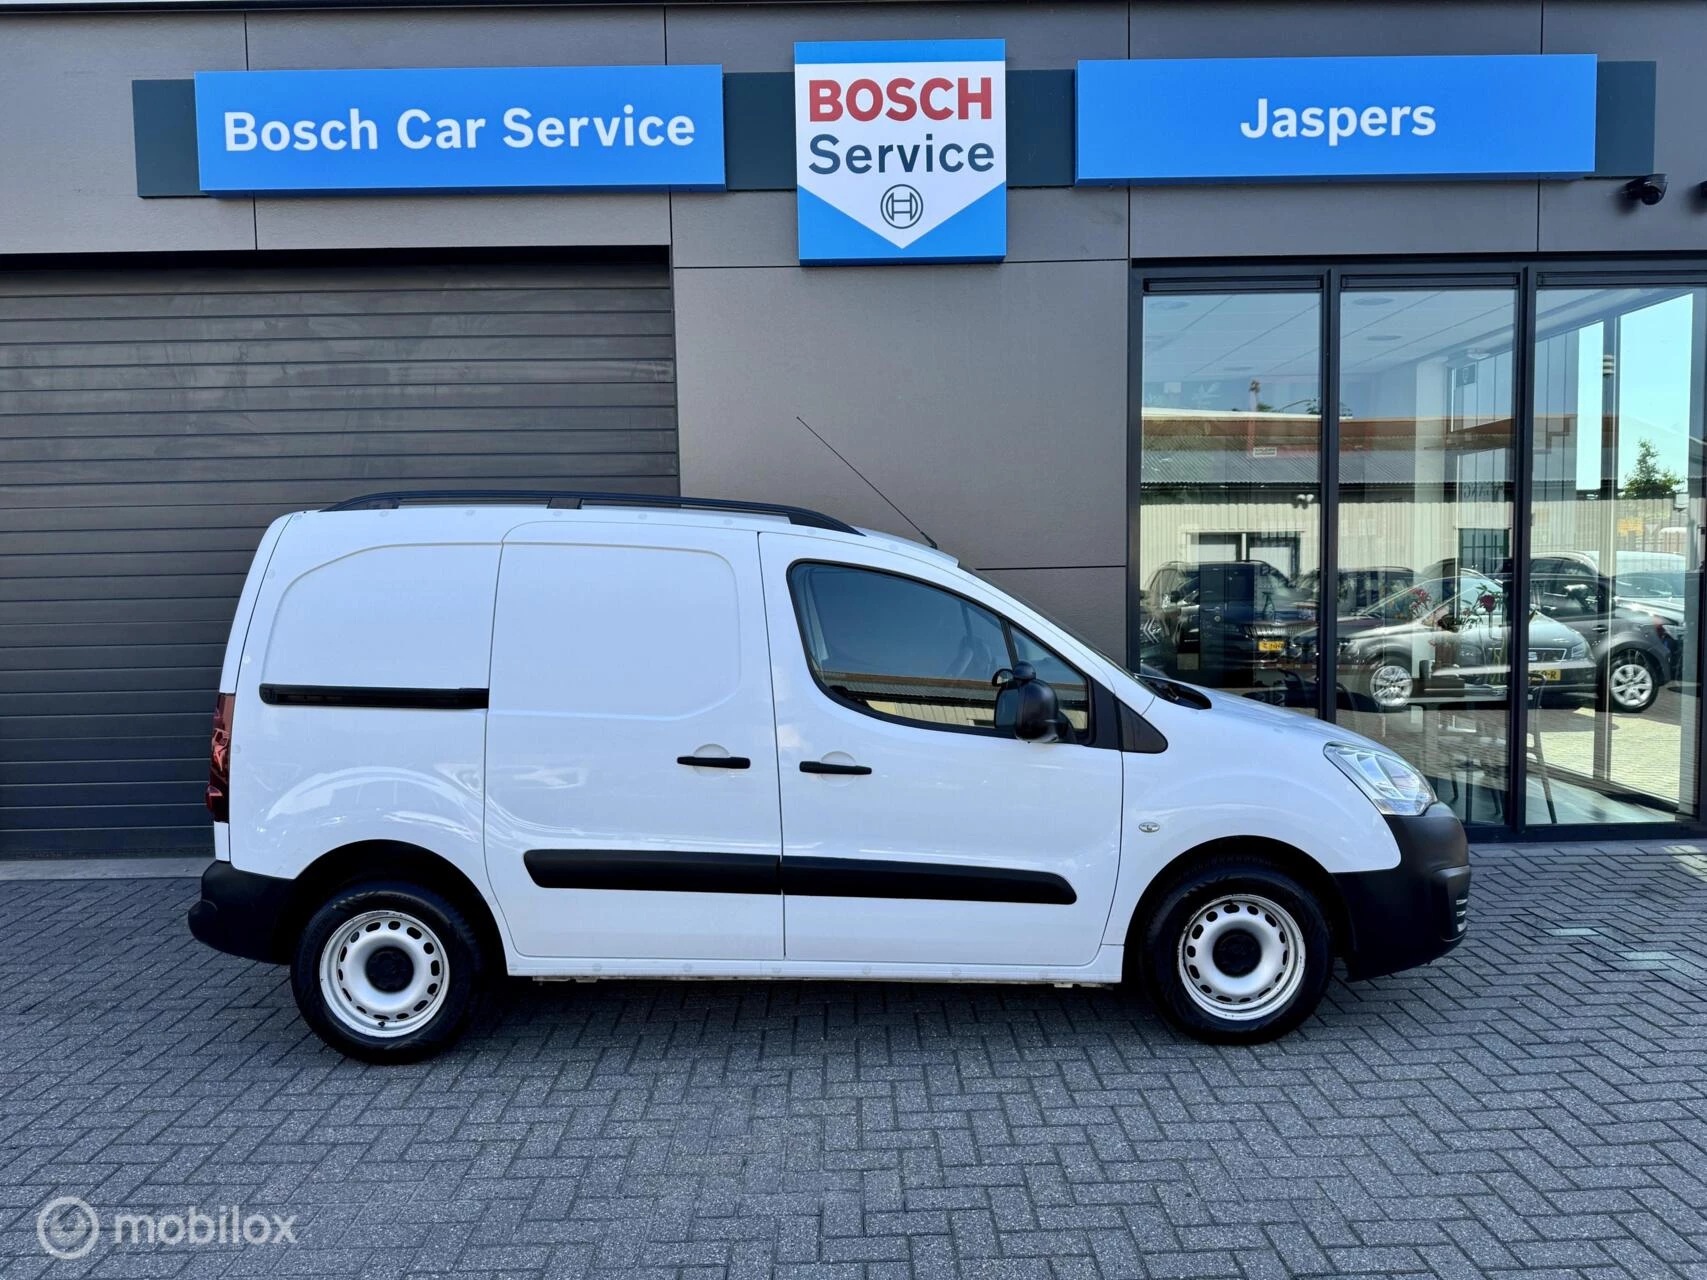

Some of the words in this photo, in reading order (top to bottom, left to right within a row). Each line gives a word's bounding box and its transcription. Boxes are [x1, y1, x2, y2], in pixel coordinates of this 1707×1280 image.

[810, 78, 991, 121] BOSCH
[225, 109, 377, 151] Bosch
[398, 109, 485, 148] Car
[504, 105, 694, 147] Service
[1241, 99, 1435, 145] Jaspers
[809, 134, 994, 174] Service
